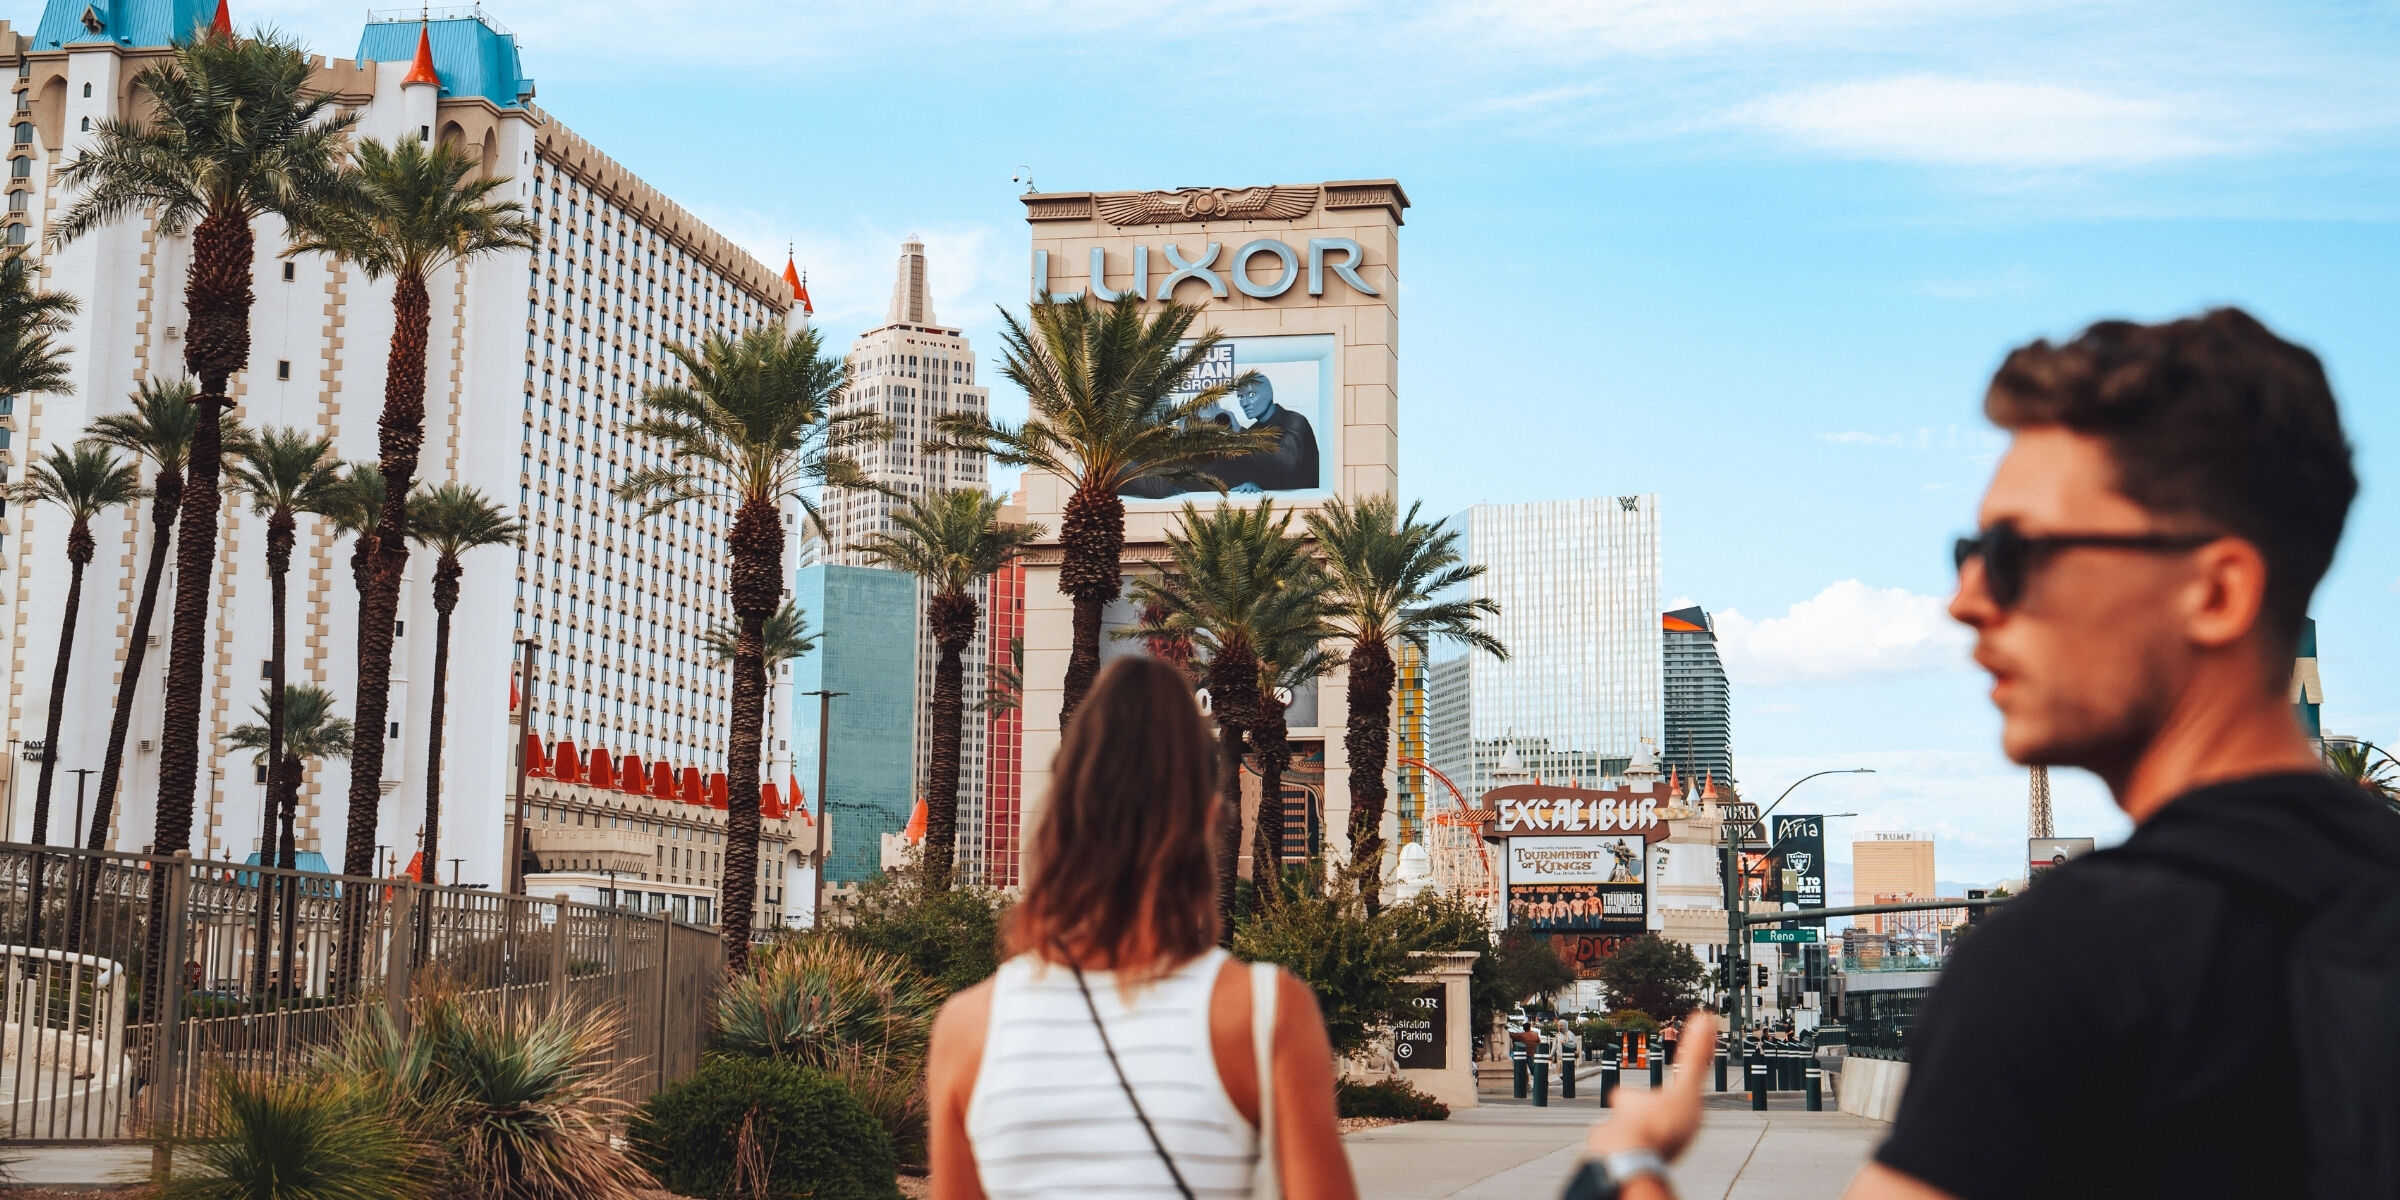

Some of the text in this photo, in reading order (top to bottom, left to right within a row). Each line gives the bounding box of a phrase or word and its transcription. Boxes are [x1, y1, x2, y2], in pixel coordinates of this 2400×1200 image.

[1033, 238, 1380, 304] LUXOR
[1500, 798, 1659, 832] EXCALIBUR
[1515, 848, 1600, 862] TOURNAMENT
[1535, 860, 1592, 874] KINGS
[1560, 885, 1598, 893] OUTBACK
[1797, 885, 1821, 893] PETE
[1602, 893, 1643, 905] THUNDER
[1603, 905, 1643, 914] DOWN UNDER
[1770, 930, 1794, 941] Reno
[1401, 1031, 1432, 1042] Parking
